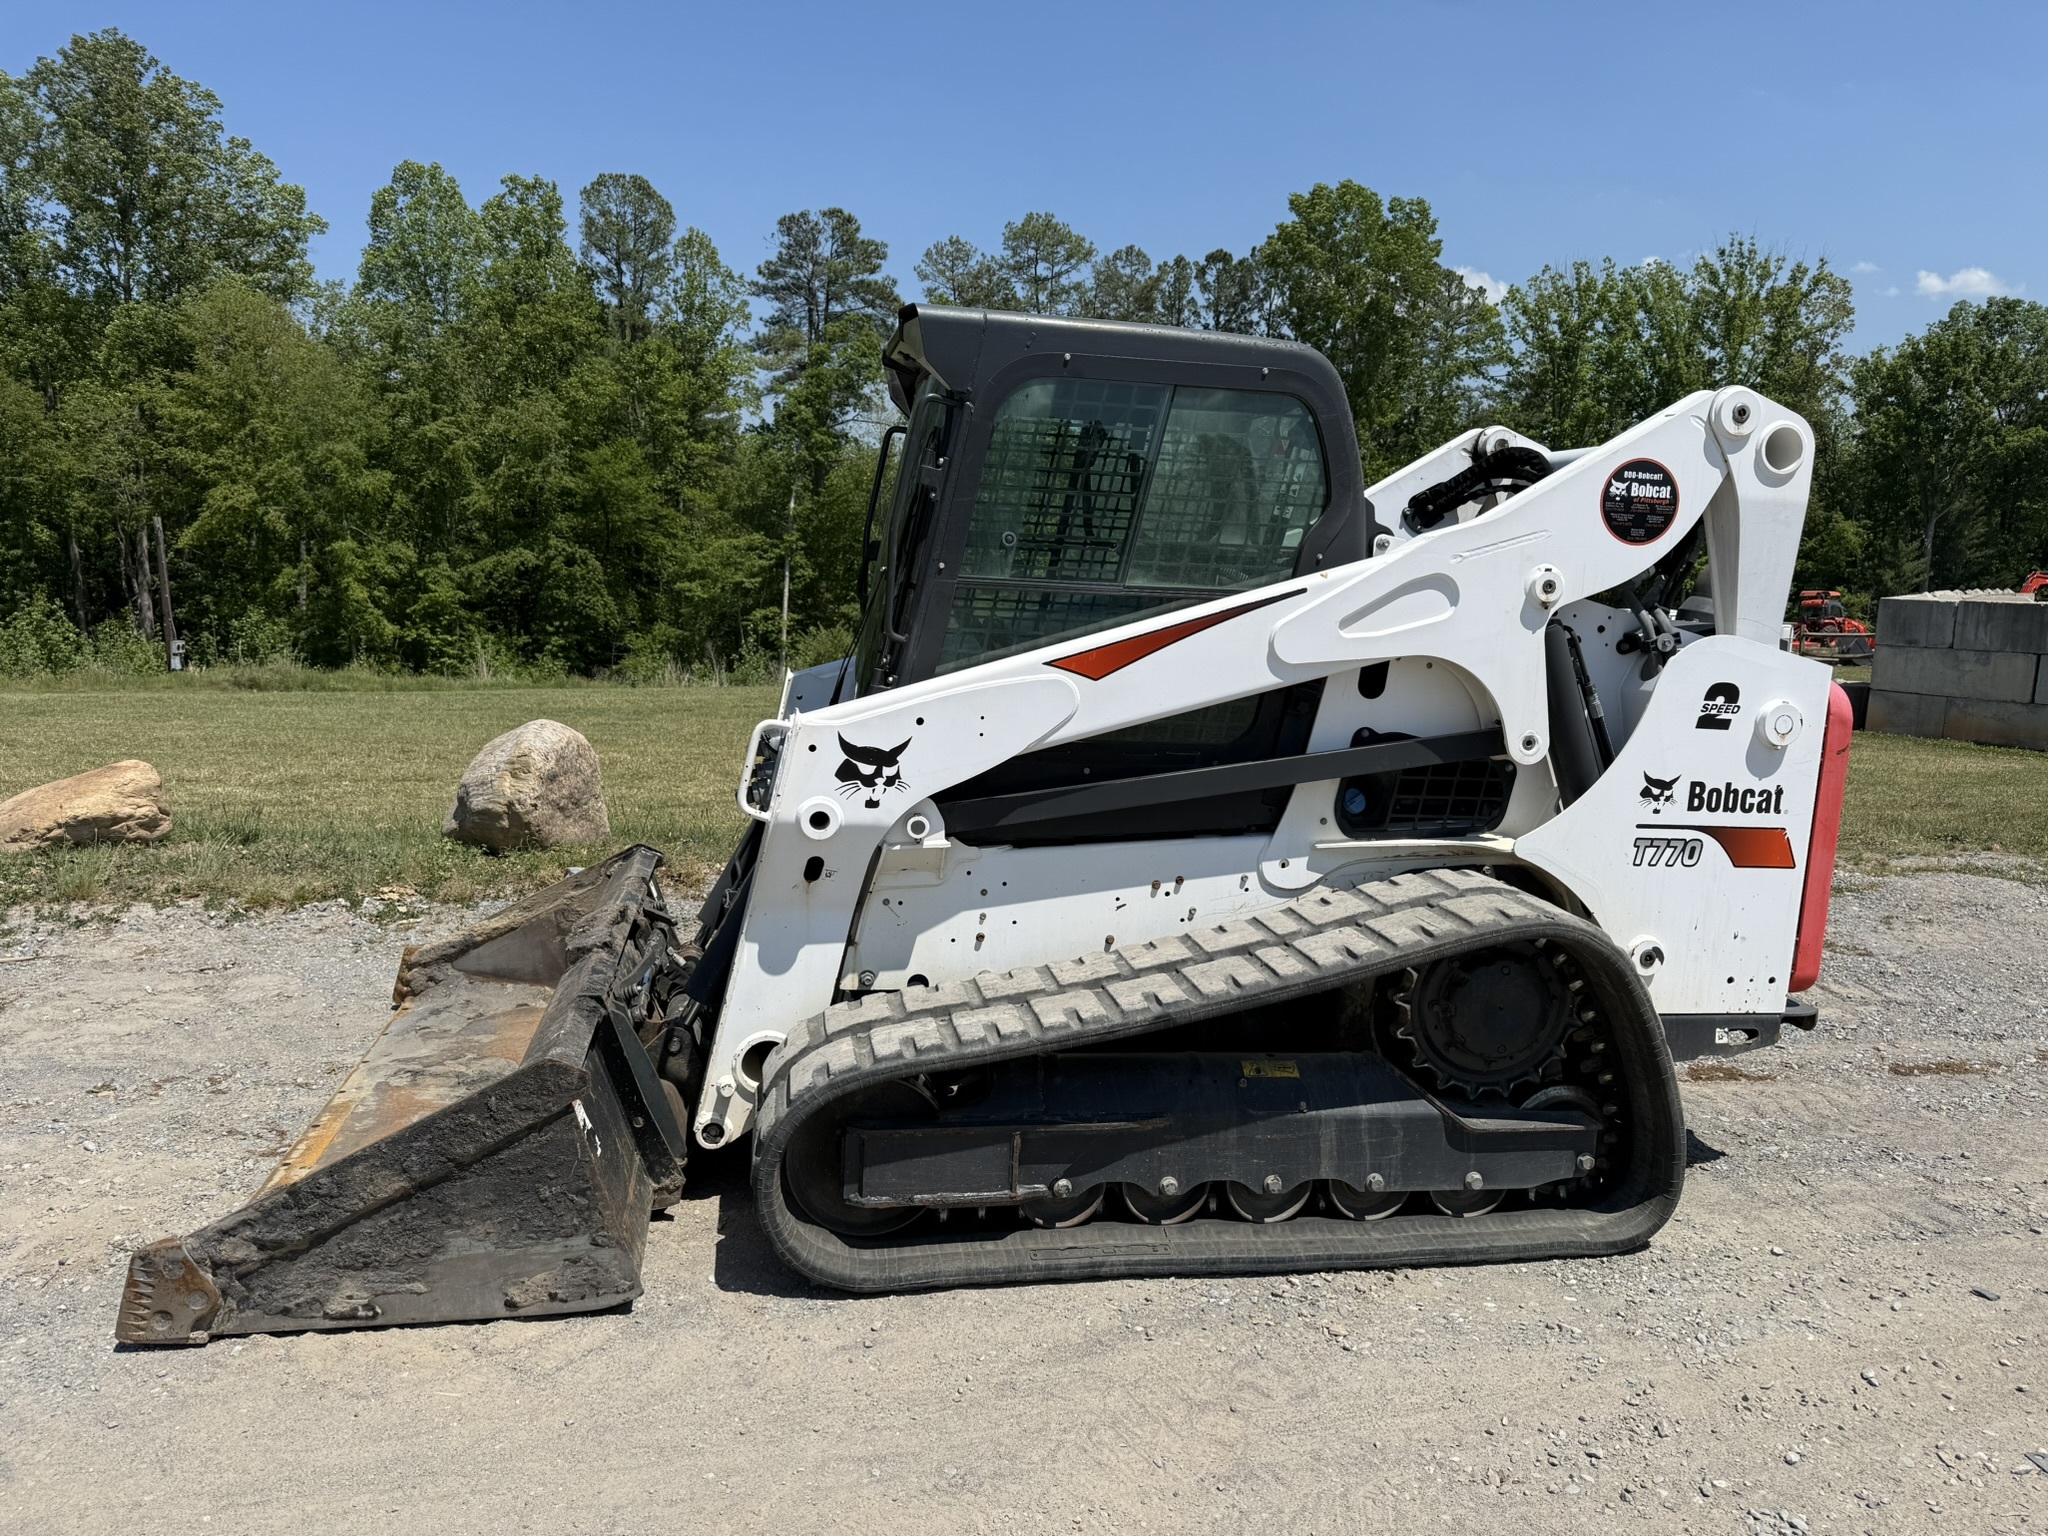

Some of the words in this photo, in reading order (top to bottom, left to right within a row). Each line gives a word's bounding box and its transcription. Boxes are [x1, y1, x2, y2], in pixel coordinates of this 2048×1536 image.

[1631, 482, 1671, 499] Bobcat
[1695, 681, 1741, 731] 2
[1700, 702, 1741, 715] SPEED
[1686, 781, 1784, 815] Bobcat
[1633, 837, 1704, 868] T770
